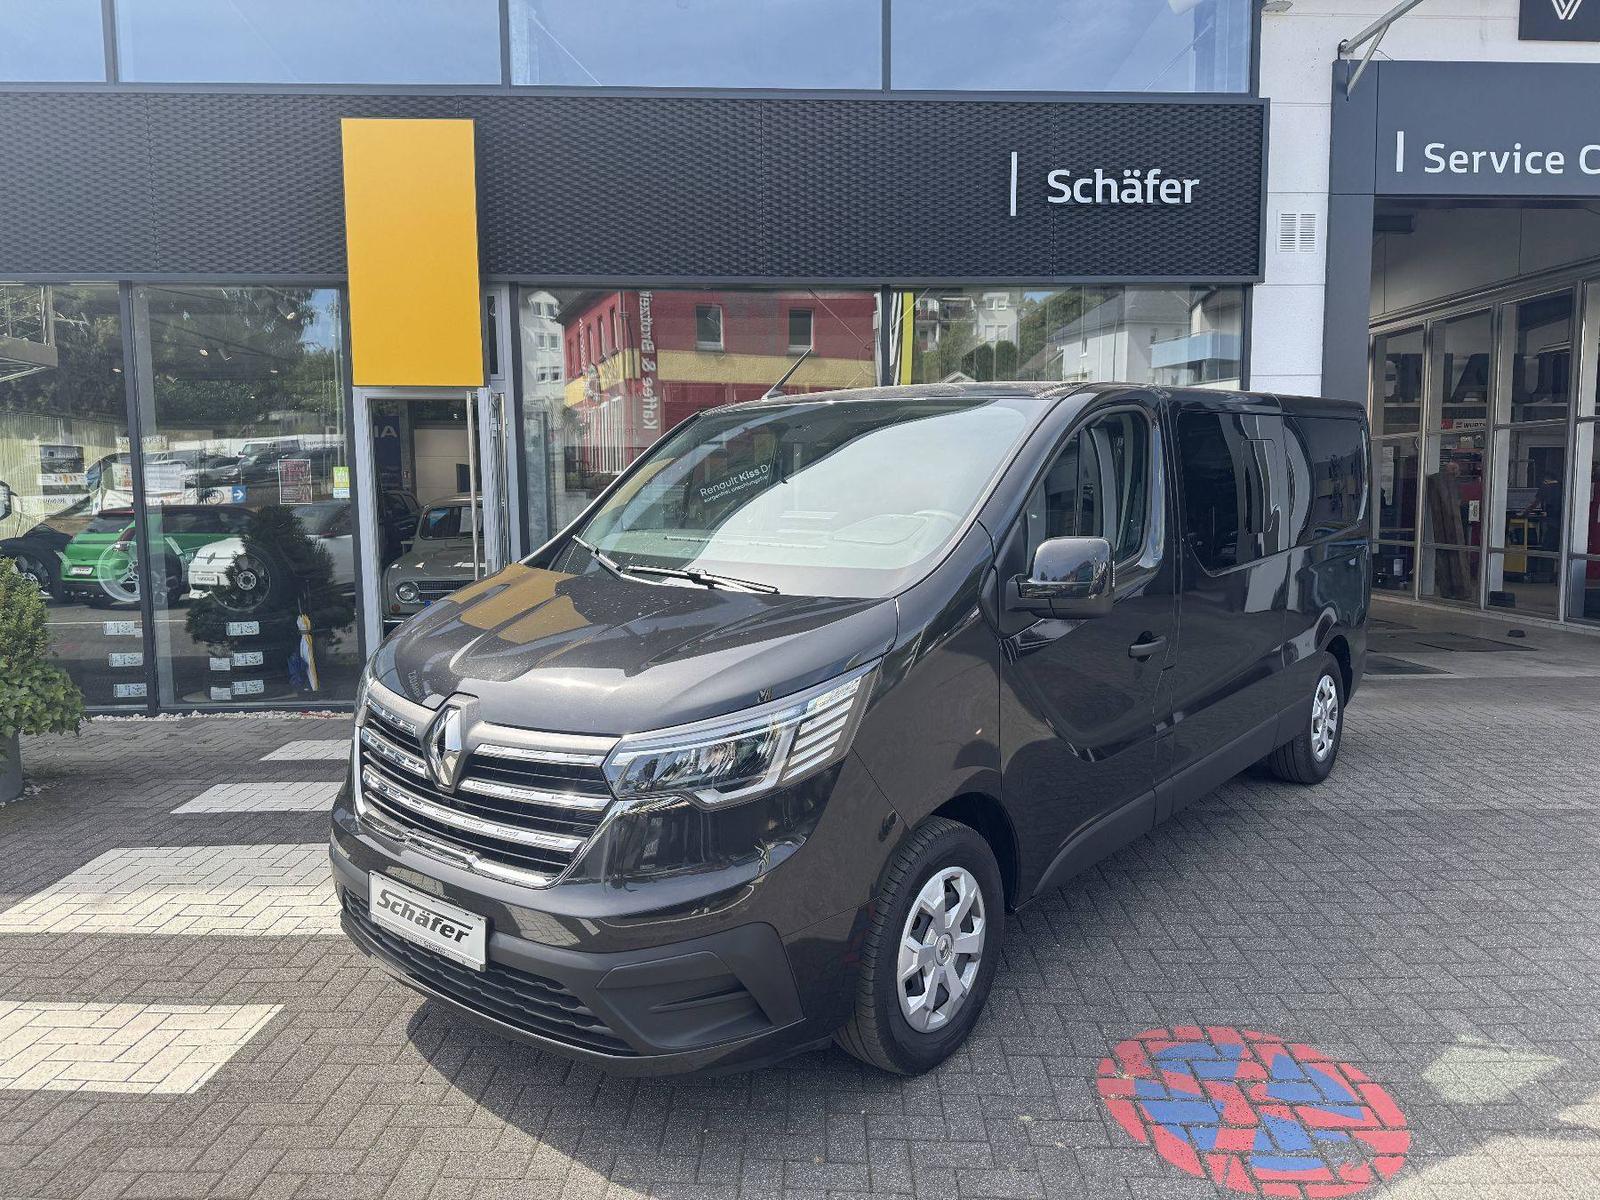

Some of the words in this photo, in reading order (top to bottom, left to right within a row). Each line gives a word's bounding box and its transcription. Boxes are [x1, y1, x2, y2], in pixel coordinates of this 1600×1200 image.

[1424, 143, 1565, 174] Service
[1047, 168, 1200, 203] Schäfer
[700, 476, 738, 497] Renault
[738, 467, 760, 482] Kiss
[376, 888, 473, 943] Schäfer
